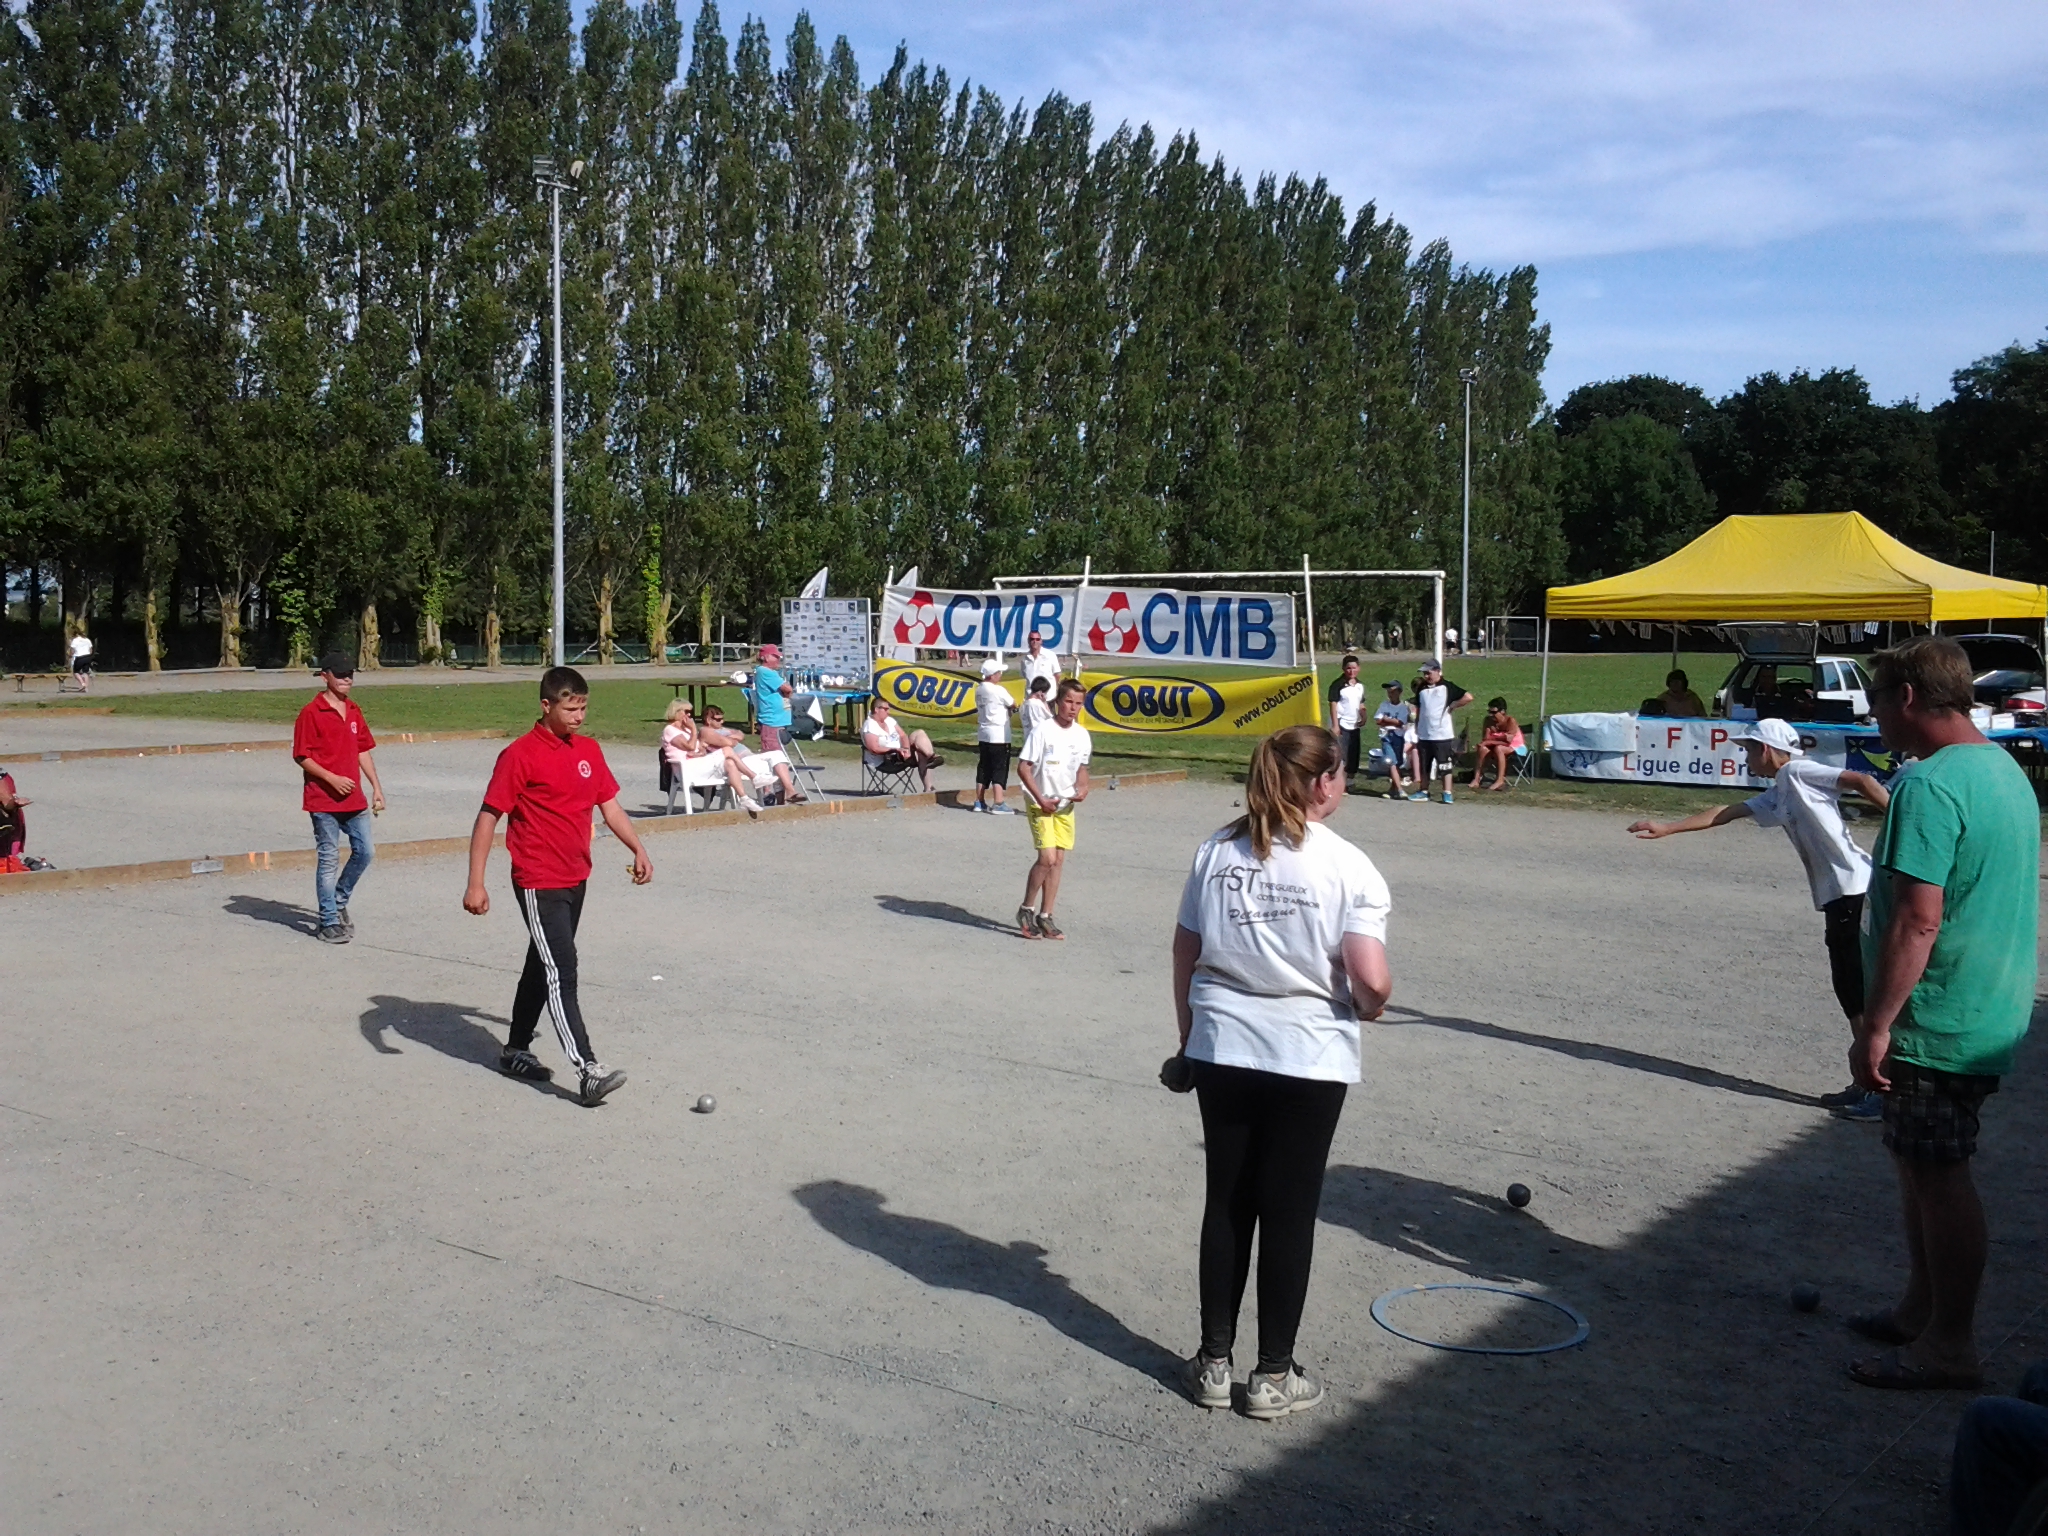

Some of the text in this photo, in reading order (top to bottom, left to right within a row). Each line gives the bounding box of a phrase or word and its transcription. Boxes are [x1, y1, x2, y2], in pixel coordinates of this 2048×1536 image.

[943, 593, 1064, 650] CMB
[1141, 592, 1277, 660] CMB
[893, 671, 975, 708] OBUT
[1111, 684, 1196, 718] OBUT
[1232, 675, 1314, 729] www.obut.com
[1623, 754, 1681, 776] Ligue
[1688, 757, 1714, 775] de
[1207, 863, 1263, 894] AST
